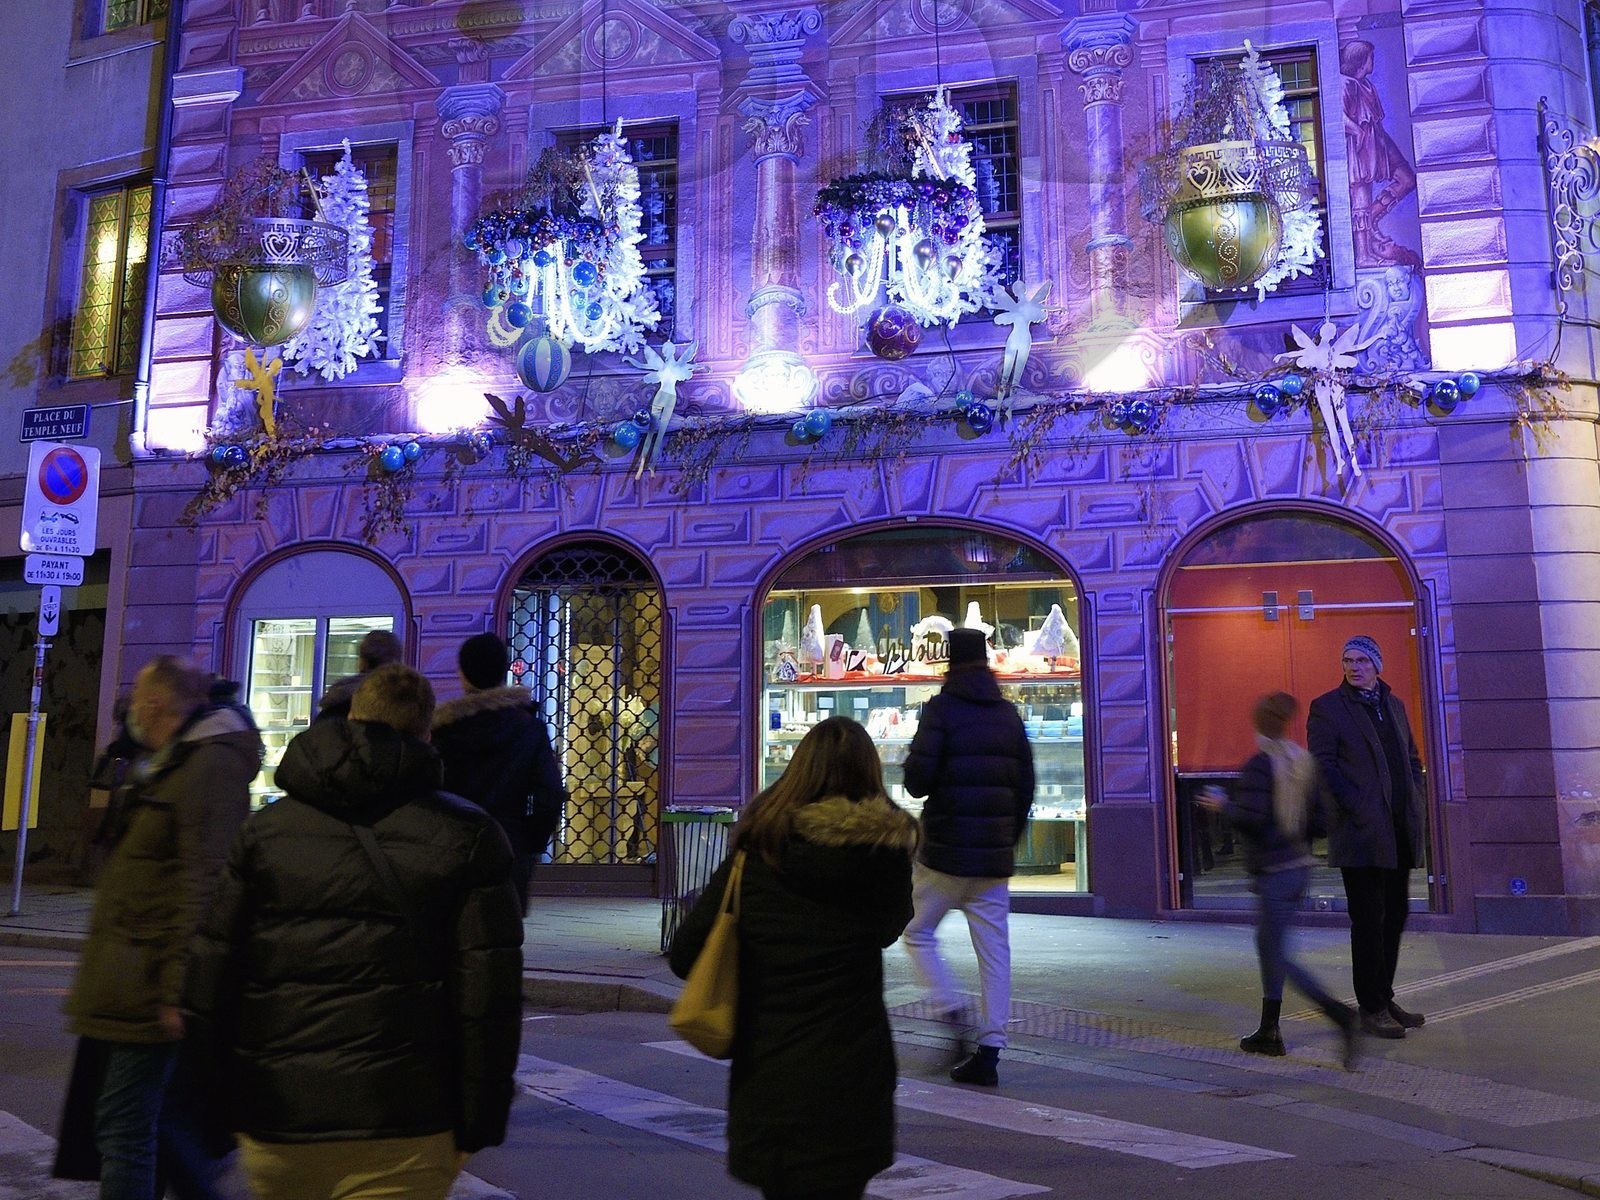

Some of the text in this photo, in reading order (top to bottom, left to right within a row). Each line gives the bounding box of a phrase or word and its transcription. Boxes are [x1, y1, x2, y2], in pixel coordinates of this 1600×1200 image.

[33, 410, 76, 423] PLACE DU
[24, 423, 83, 437] TEMPLE NEUF
[40, 536, 77, 544] OUVRABLES
[41, 560, 70, 569] PAYANT
[35, 571, 55, 579] 11h30
[62, 572, 81, 581] 19h00
[877, 624, 950, 663] Christia
